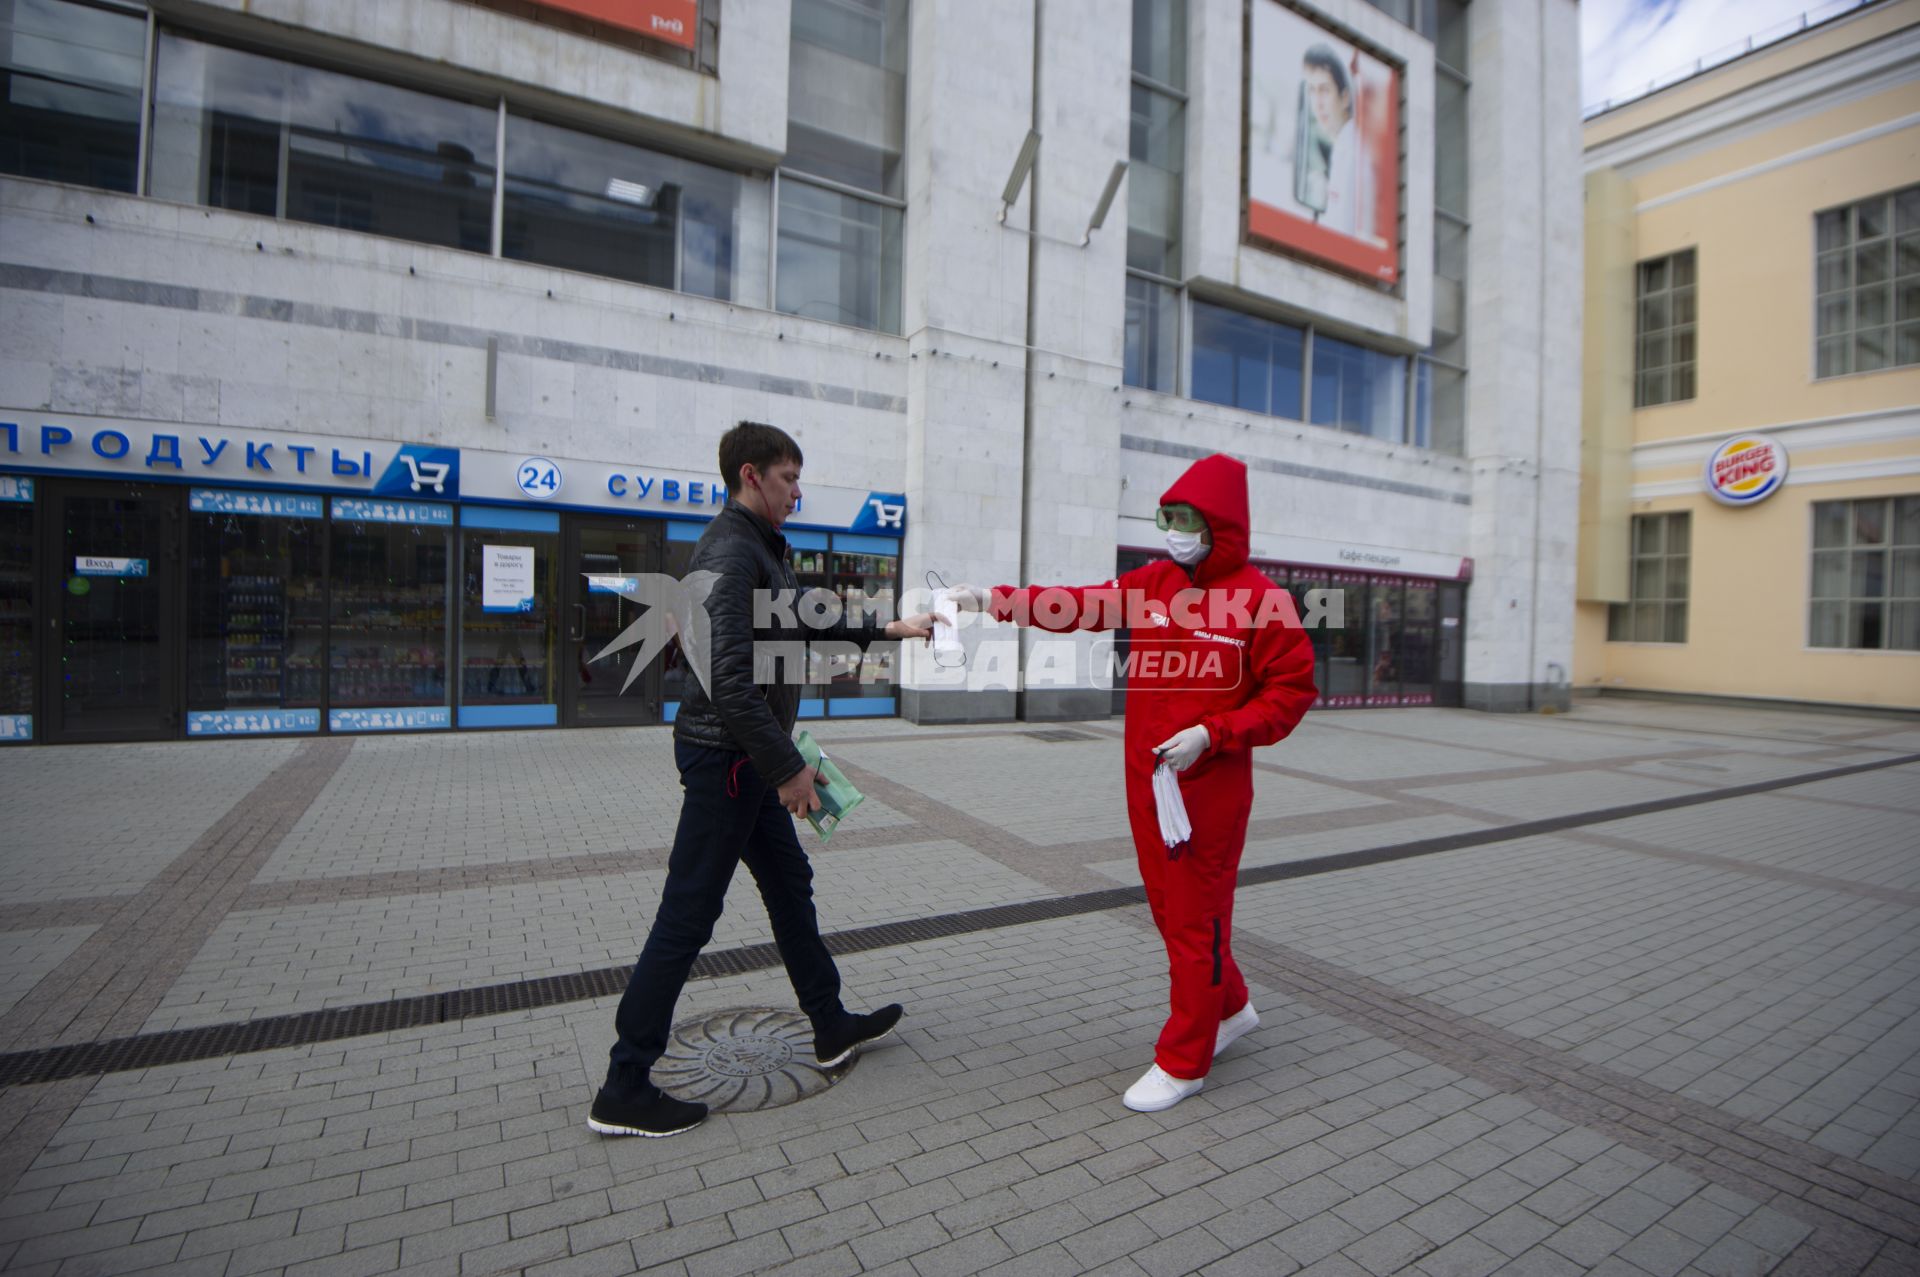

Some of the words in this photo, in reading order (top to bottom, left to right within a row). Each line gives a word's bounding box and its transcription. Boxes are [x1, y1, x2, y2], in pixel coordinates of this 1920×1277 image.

[1716, 445, 1773, 473] BURGER
[1716, 456, 1775, 490] KING
[522, 467, 556, 489] 24
